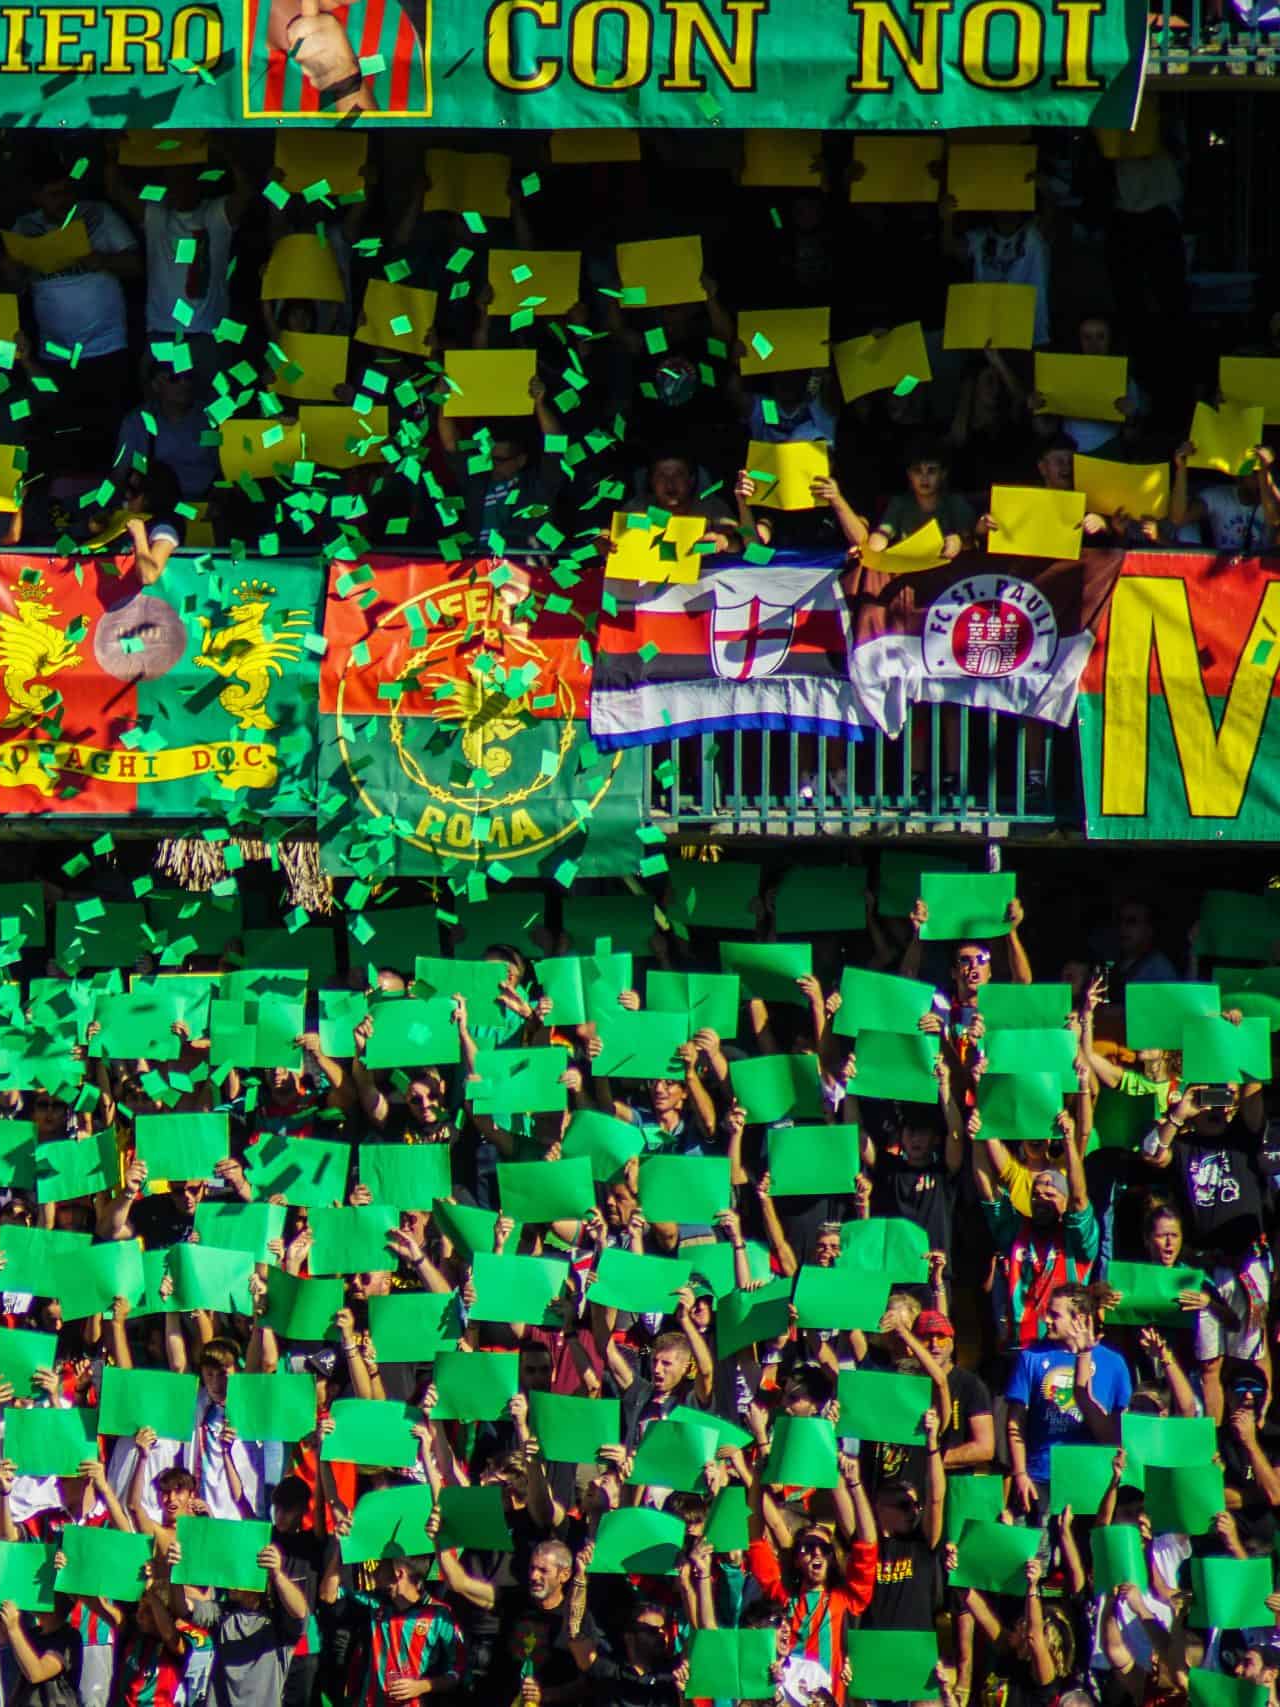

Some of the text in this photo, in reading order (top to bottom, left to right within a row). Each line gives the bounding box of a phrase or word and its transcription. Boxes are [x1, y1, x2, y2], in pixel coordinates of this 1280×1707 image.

[483, 0, 765, 93] CON
[849, 0, 1109, 94] NOI
[930, 577, 1055, 637] FC ST. PAULI
[415, 804, 545, 848] ROMA
